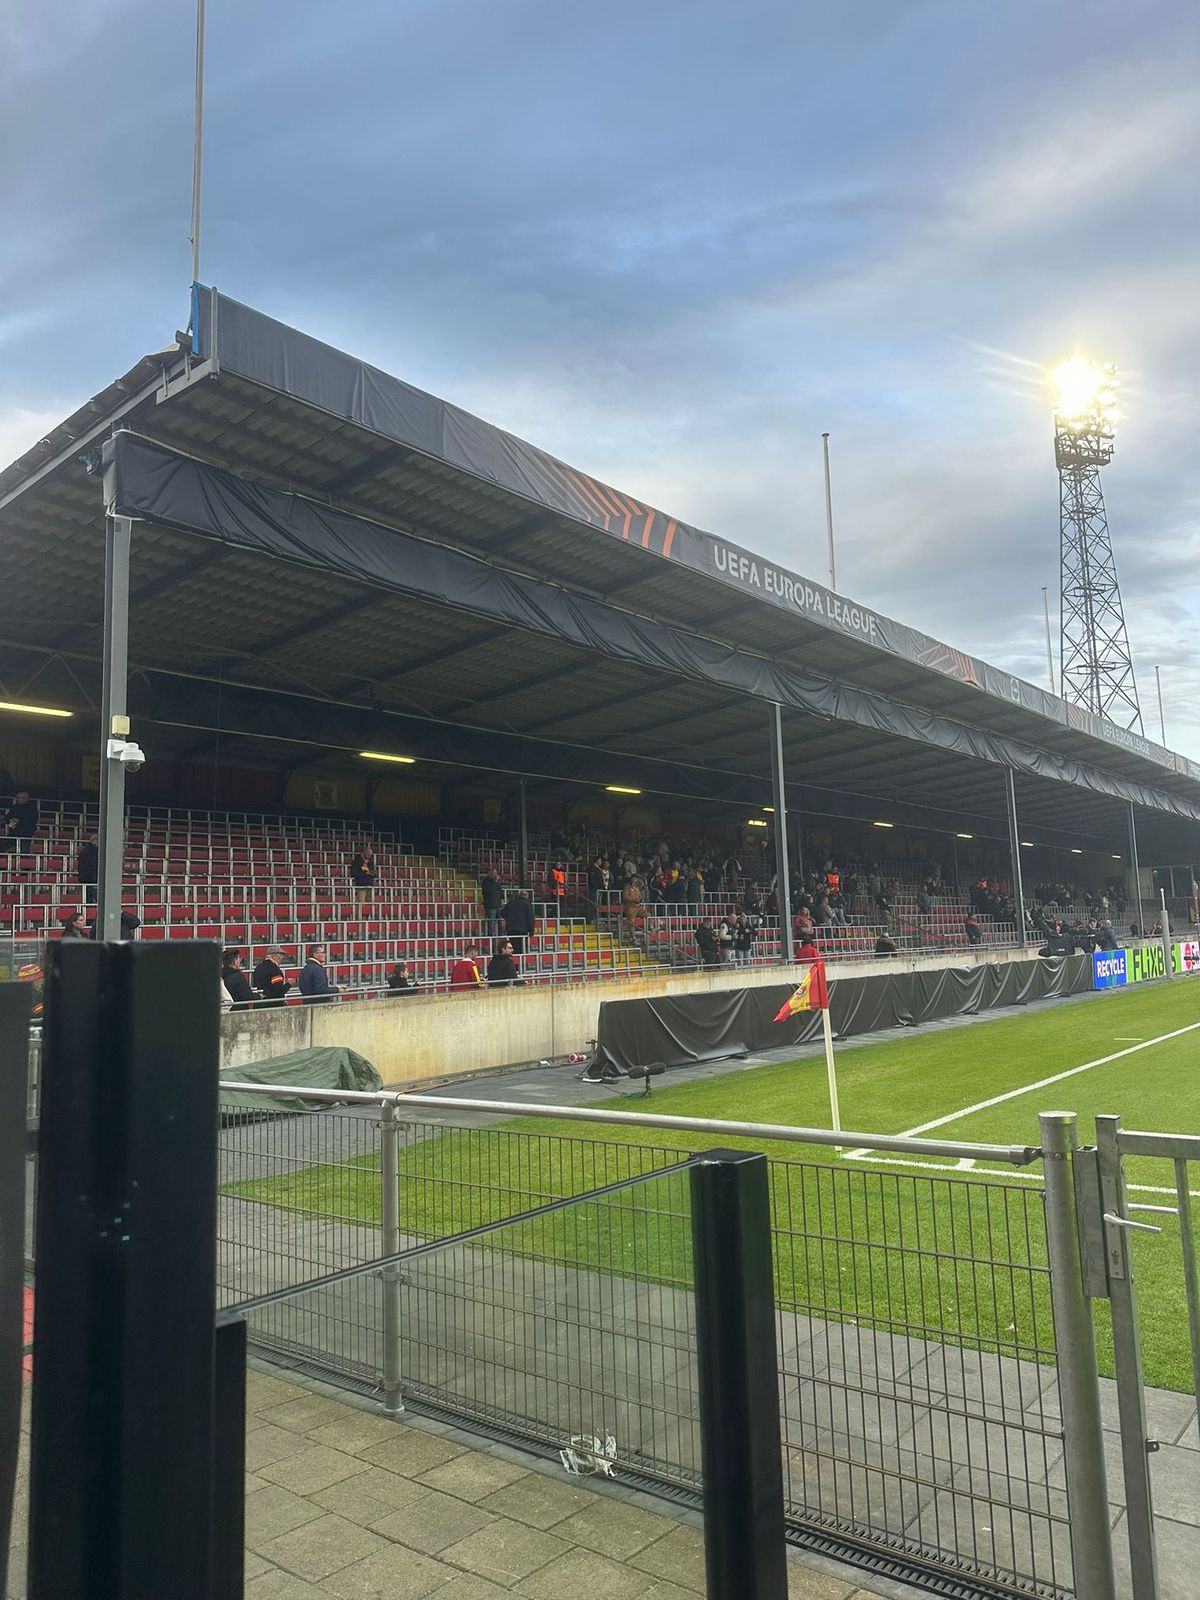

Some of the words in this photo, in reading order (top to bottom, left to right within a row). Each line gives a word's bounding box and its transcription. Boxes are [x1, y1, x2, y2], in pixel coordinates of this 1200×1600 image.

[713, 544, 761, 588] UEFA
[764, 567, 824, 615] EUROPA
[826, 595, 877, 638] LEAGUE
[1097, 958, 1125, 977] RECYCLE
[1132, 945, 1176, 981] FLIXBS
